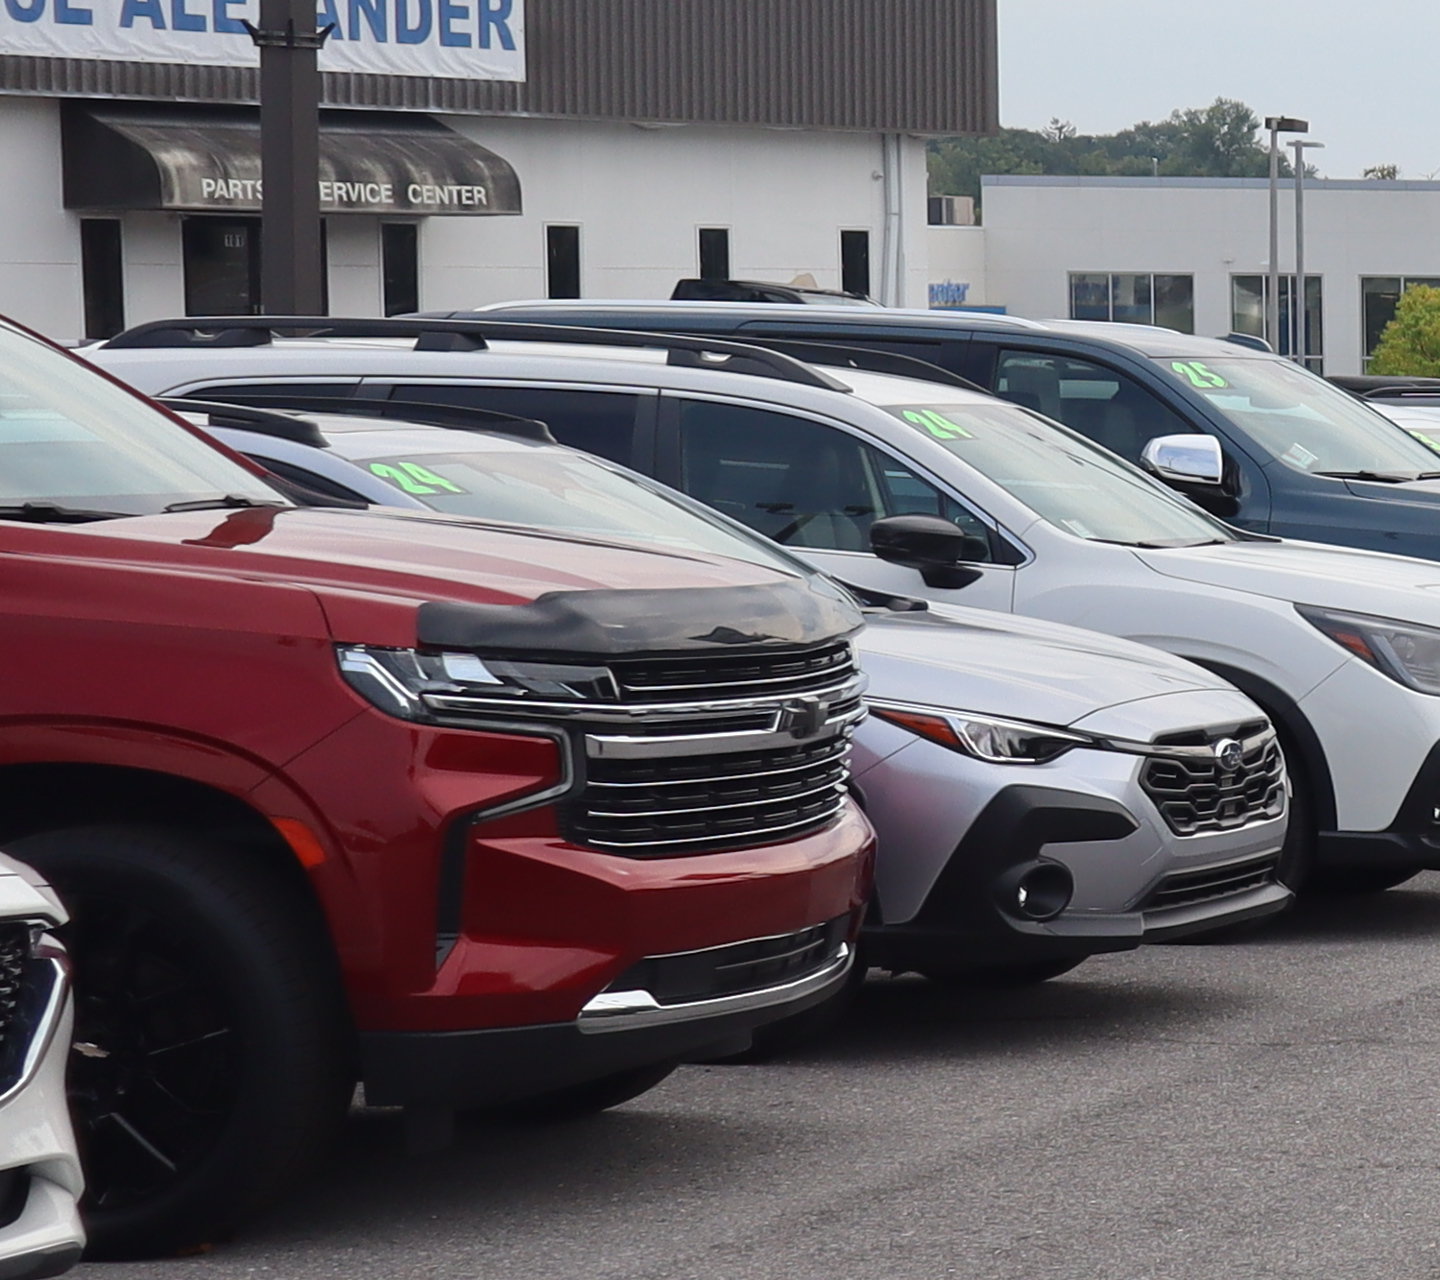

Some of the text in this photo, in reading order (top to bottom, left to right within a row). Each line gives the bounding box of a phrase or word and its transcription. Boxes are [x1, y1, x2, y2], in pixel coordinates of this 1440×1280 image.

[318, 181, 394, 203] ERVICE
[407, 184, 487, 206] CENTER
[1171, 360, 1229, 389] 25
[902, 408, 972, 440] 24
[369, 460, 462, 496] 24
